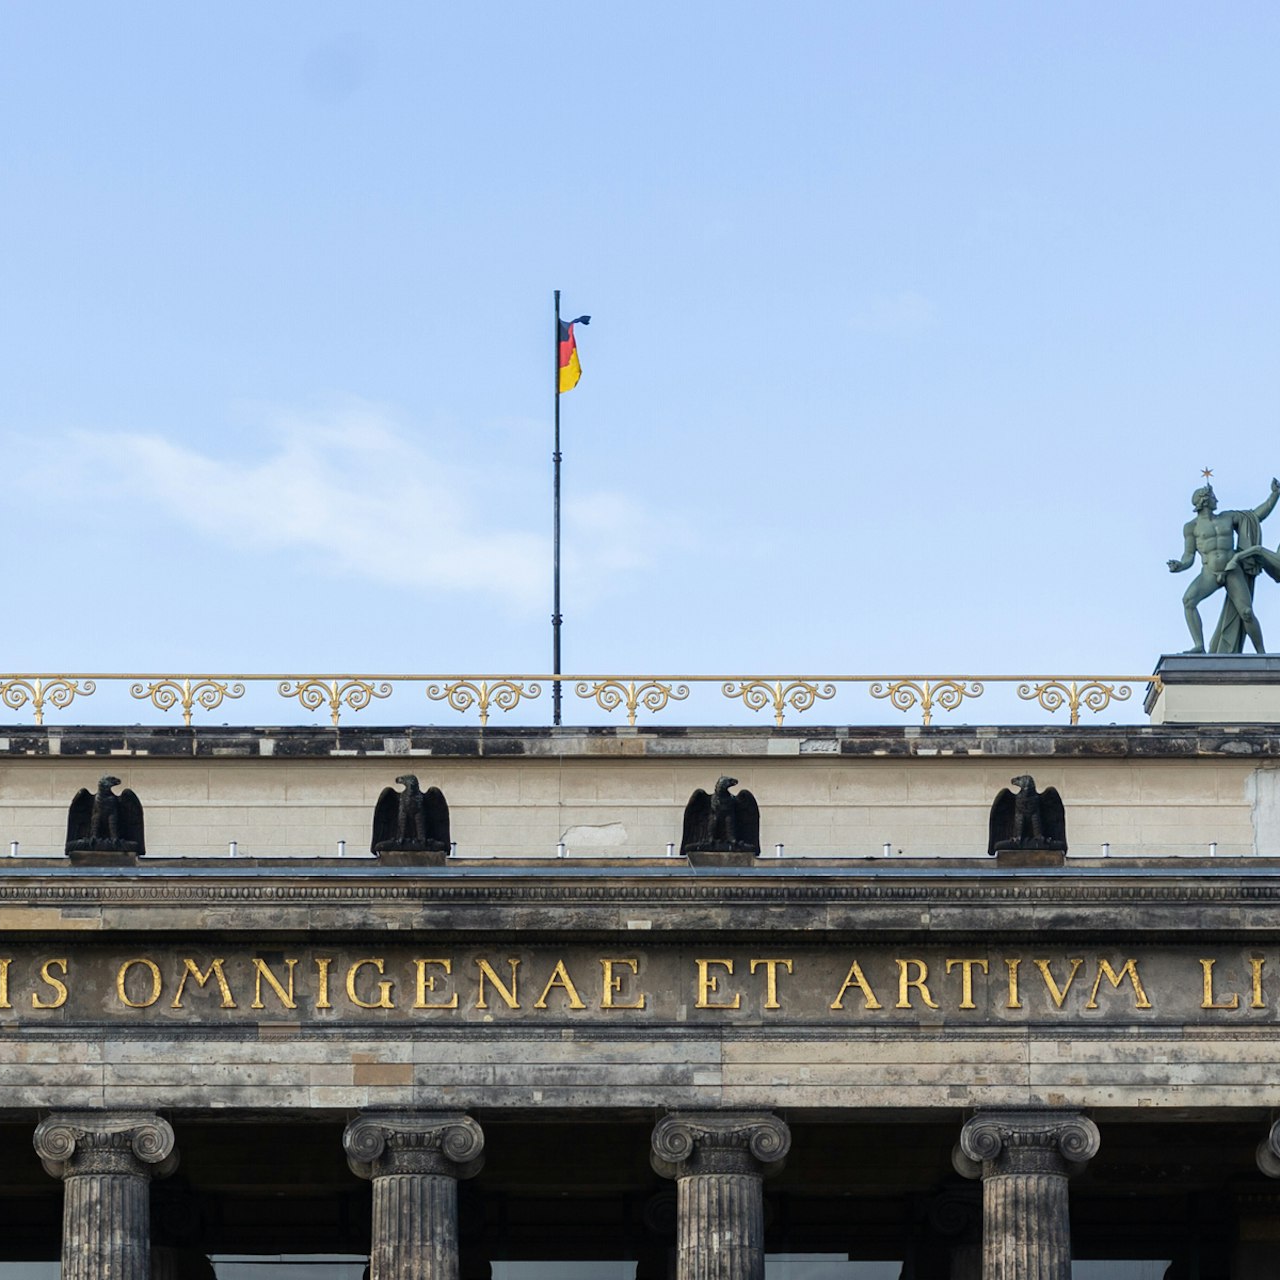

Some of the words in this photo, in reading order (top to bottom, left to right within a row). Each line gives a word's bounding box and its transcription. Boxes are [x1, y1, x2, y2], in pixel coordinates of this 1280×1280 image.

[116, 958, 646, 1009] OMNIGENAE
[695, 958, 794, 1009] ET
[830, 958, 1153, 1009] ARTIVM
